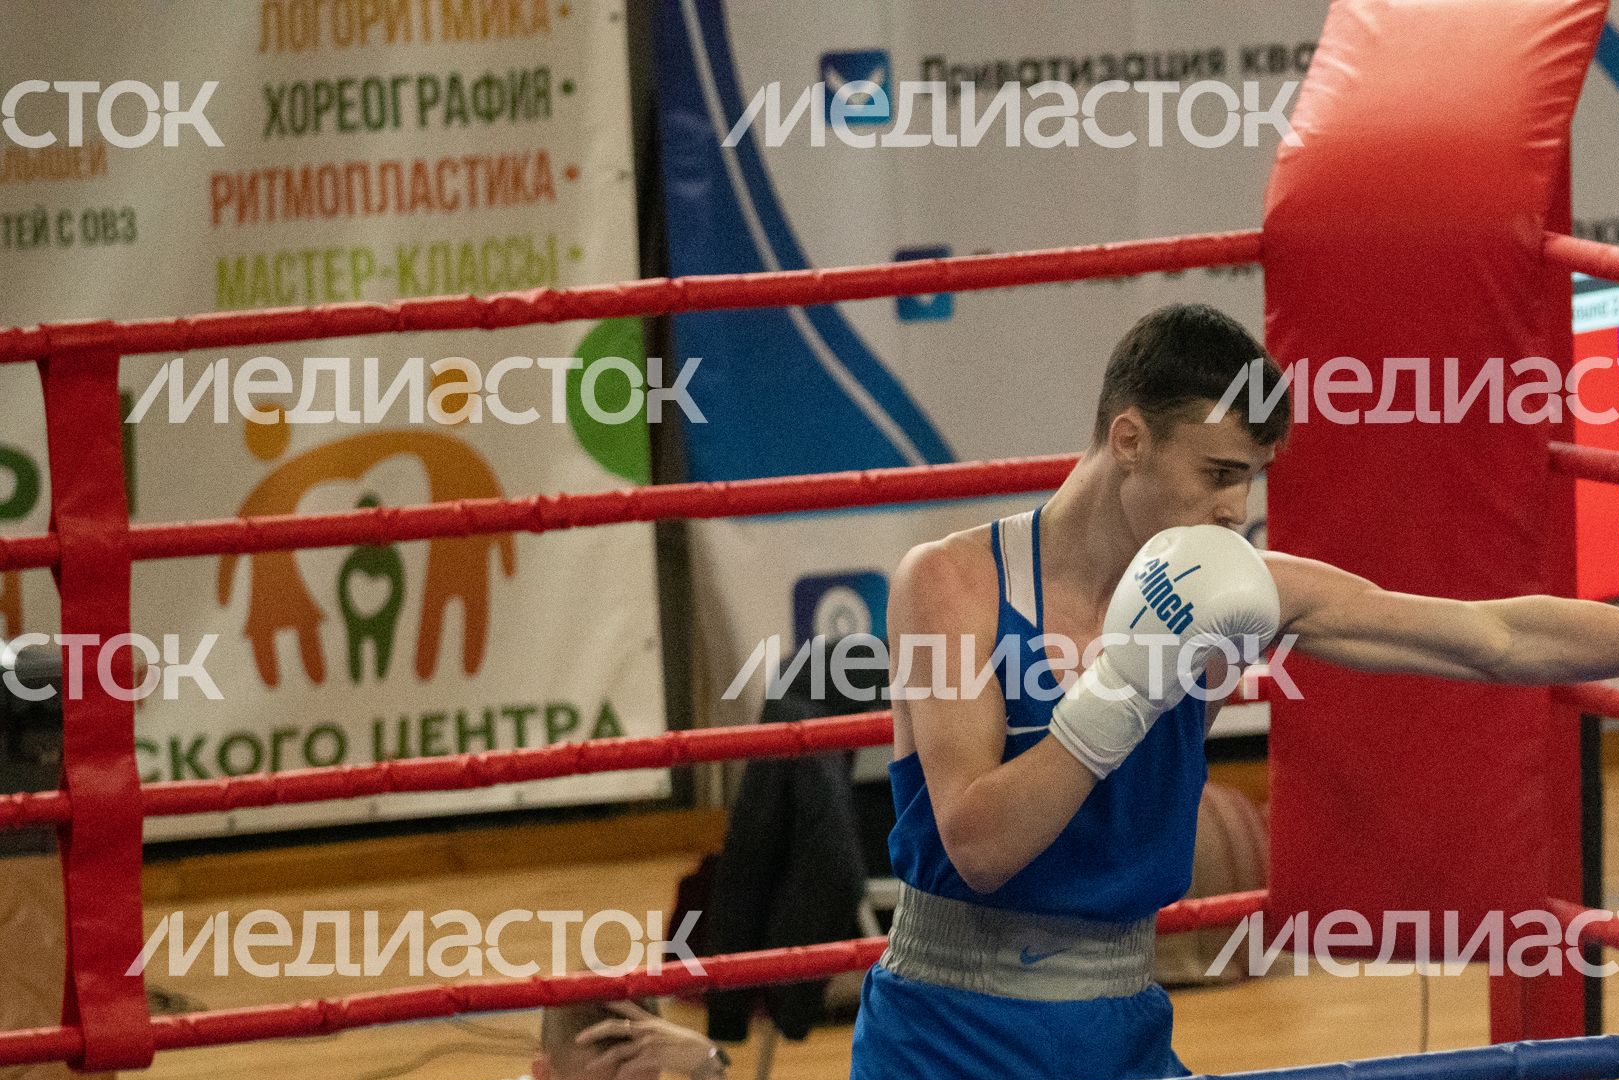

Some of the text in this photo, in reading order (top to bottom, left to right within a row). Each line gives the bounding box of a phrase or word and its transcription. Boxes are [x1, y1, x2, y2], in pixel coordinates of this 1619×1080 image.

[259, 0, 551, 54] ЛОГОРИТМИКА
[263, 66, 553, 140] ХОРЕОГРАФИЯ
[210, 149, 557, 228] РИТМОПЛАСТИКА
[215, 233, 558, 310] МАСТЕР-КЛАССЫ
[1134, 558, 1195, 635] clinch
[375, 701, 625, 763] ЦЕНТРА
